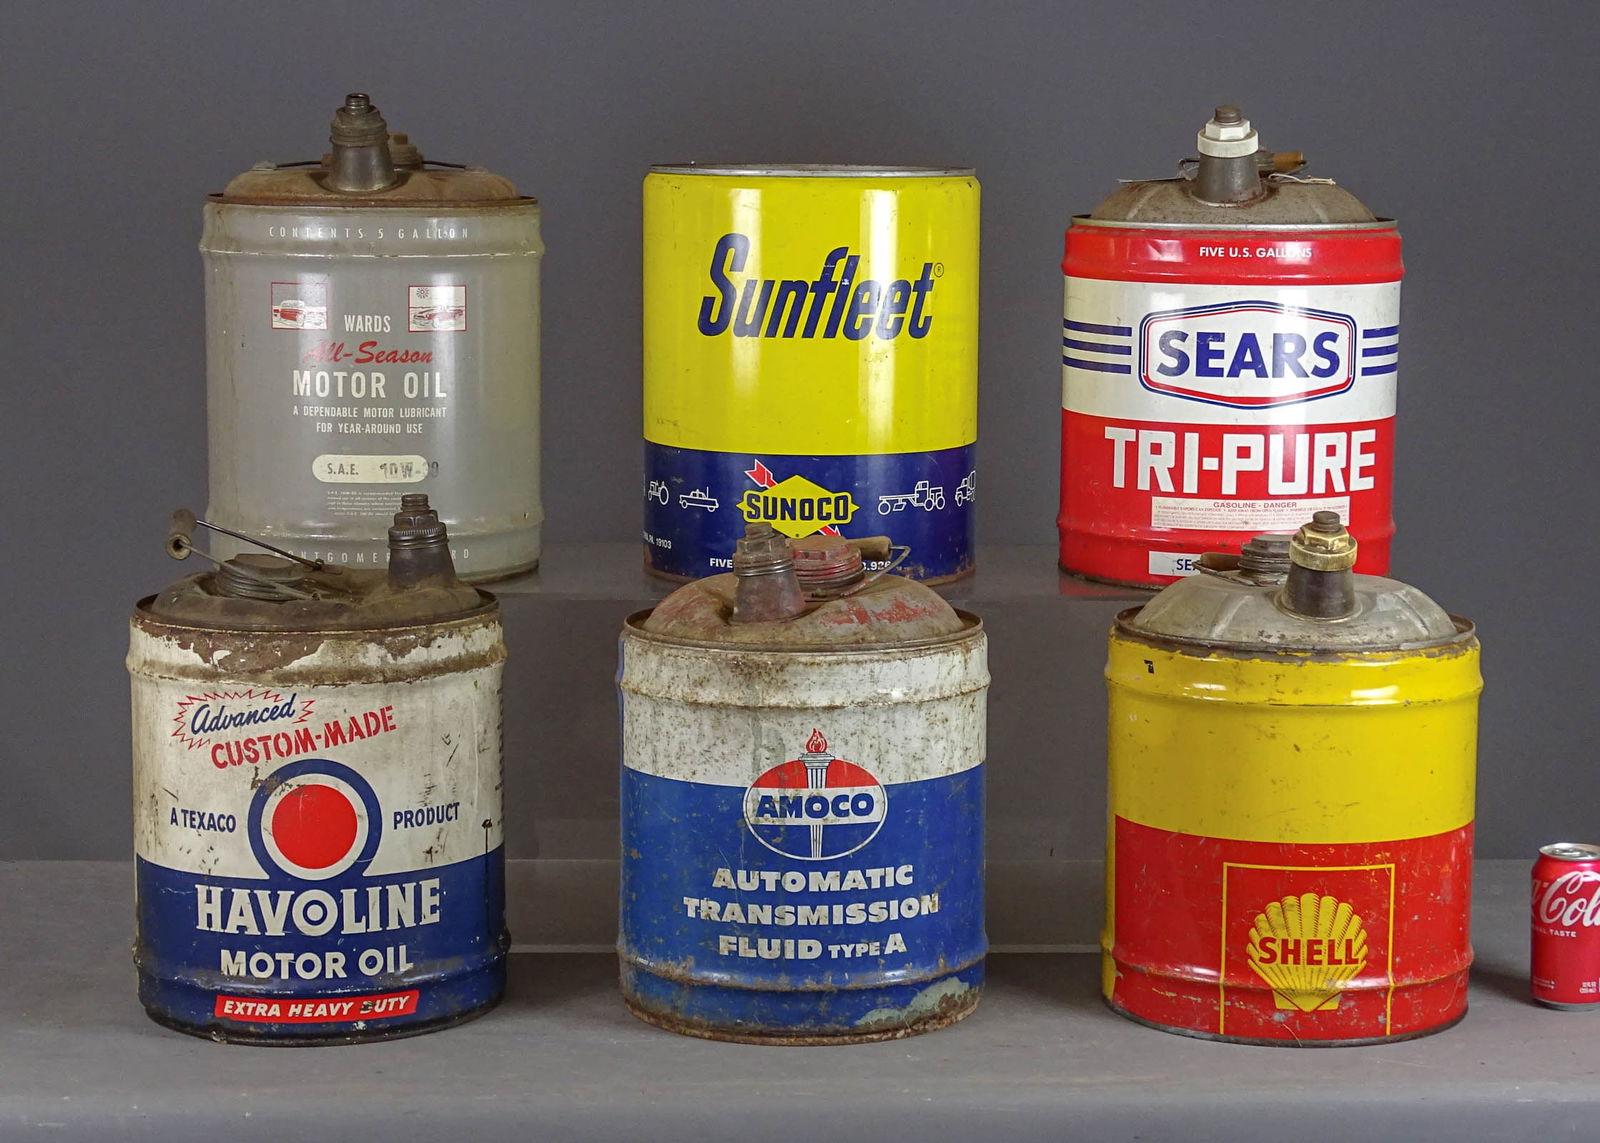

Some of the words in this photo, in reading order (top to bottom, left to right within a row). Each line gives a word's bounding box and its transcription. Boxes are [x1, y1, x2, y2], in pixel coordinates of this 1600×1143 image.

[269, 226, 364, 239] CONTENTS
[378, 228, 384, 239] 5
[398, 228, 468, 239] GALLON
[1200, 246, 1225, 257] FIVE
[1229, 247, 1253, 258] U.S.
[1256, 247, 1312, 258] GALLONS
[344, 315, 391, 333] WARDS
[302, 341, 433, 364] All-Season
[1156, 329, 1340, 379] SEARS
[293, 371, 386, 398] MOTOR
[404, 371, 448, 398] OIL
[293, 405, 299, 415] A
[303, 406, 358, 418] DEPENDABLE
[363, 407, 394, 418] MOTOR
[400, 407, 447, 418] LUBRICANT
[316, 422, 333, 433] FOR
[338, 423, 401, 434] YEAR-AROUND
[406, 423, 423, 434] USE
[327, 463, 359, 476] S.A.E.
[1105, 426, 1377, 495] TRI-PURE
[746, 498, 849, 521] SUNOCO
[1263, 501, 1297, 509] DANGER
[655, 537, 672, 549] 19103
[709, 557, 733, 569] FIVE
[190, 693, 296, 735] Advanced
[211, 705, 397, 770] CUSTOM-MADE
[170, 807, 179, 827] A
[181, 808, 237, 833] TEXACO
[393, 802, 461, 830] PRODUCT
[755, 792, 875, 819] AMOCO
[712, 864, 914, 893] AUTOMATIC
[194, 877, 441, 937] HAVOLINE
[683, 892, 939, 926] TRANSMISSION
[719, 935, 823, 960] FLUID
[828, 941, 881, 959] TYPE
[884, 933, 908, 955] A
[1258, 936, 1359, 966] SHELL
[220, 949, 348, 980] MOTOR
[358, 945, 415, 976] OIL
[223, 999, 281, 1017] EXTRA
[288, 1002, 354, 1017] HEAVY
